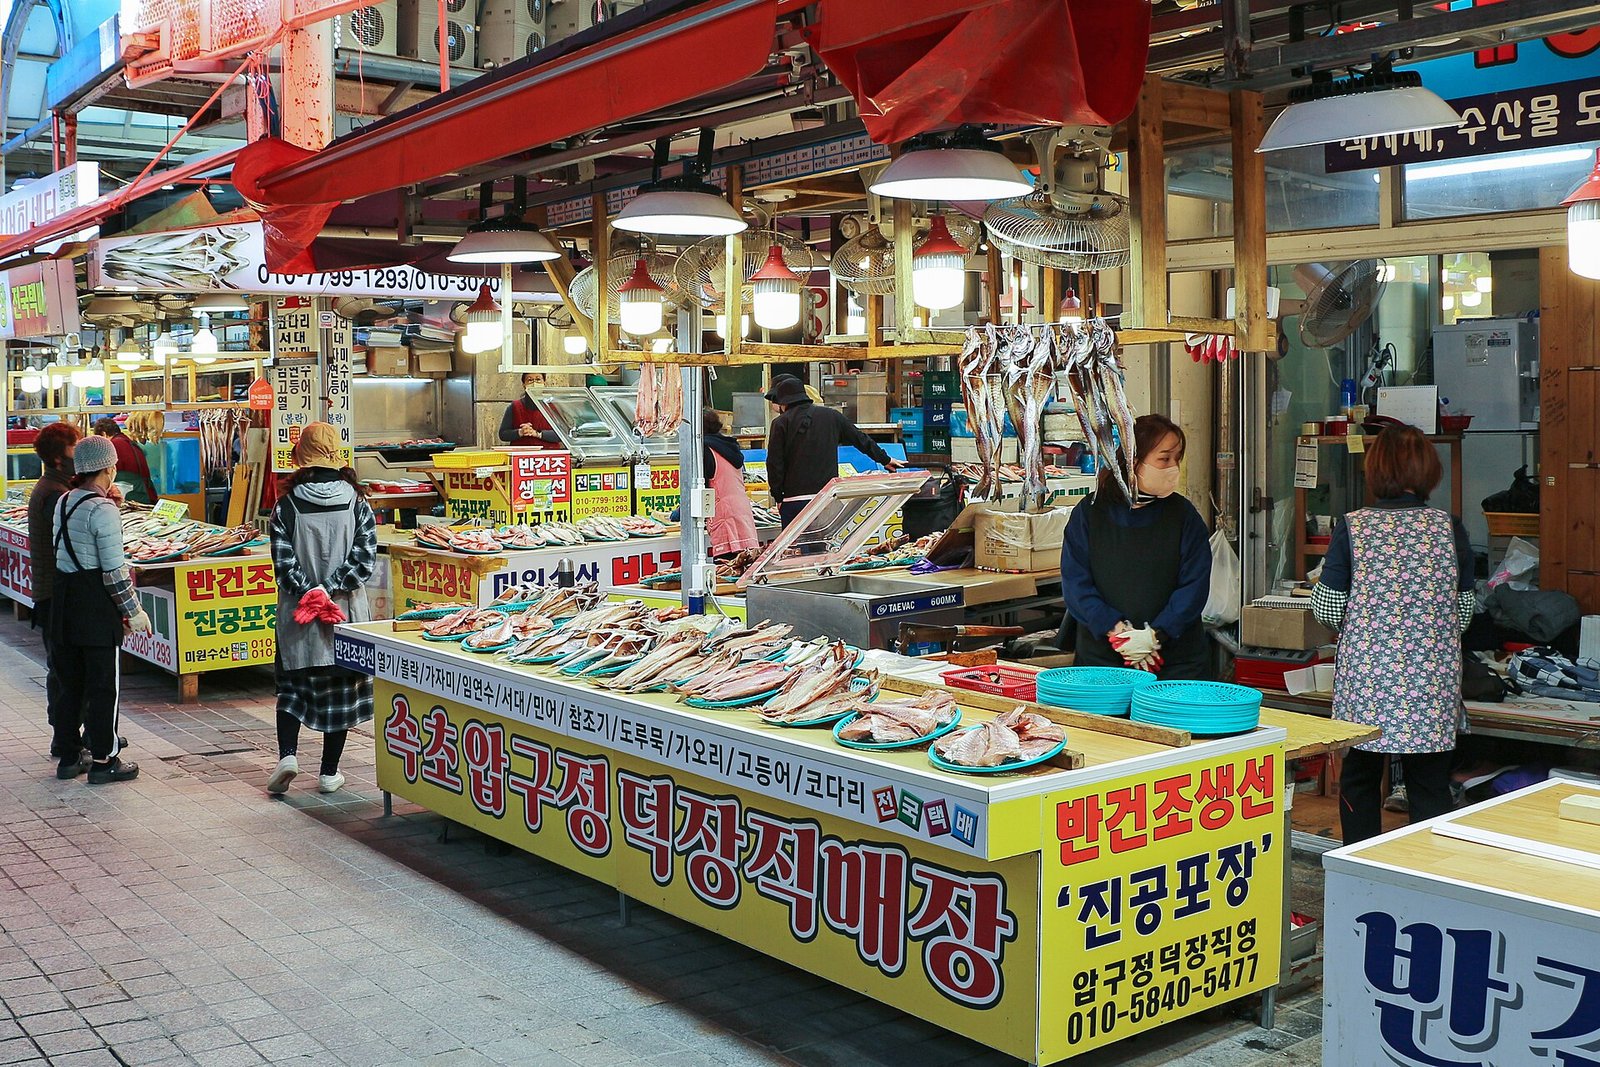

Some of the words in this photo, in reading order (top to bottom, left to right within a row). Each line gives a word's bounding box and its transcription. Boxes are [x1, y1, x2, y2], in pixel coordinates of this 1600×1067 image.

[1457, 94, 1561, 146] 수산물
[280, 331, 306, 344] 서대
[519, 457, 567, 477] 반건조
[576, 473, 628, 491] 전국택배
[576, 495, 628, 505] 010-7799-1293
[400, 558, 472, 599] 반건조생선
[888, 601, 915, 613] TAEVAC
[930, 594, 957, 606] 600MX
[186, 647, 229, 663] 미원수산
[335, 639, 374, 669] 반건조생선
[876, 789, 974, 841] 전국택배
[1056, 754, 1274, 866] 반건조생선
[1072, 918, 1257, 1006] 압구정덕장직영
[1067, 952, 1259, 1045] 010-5840-5477
